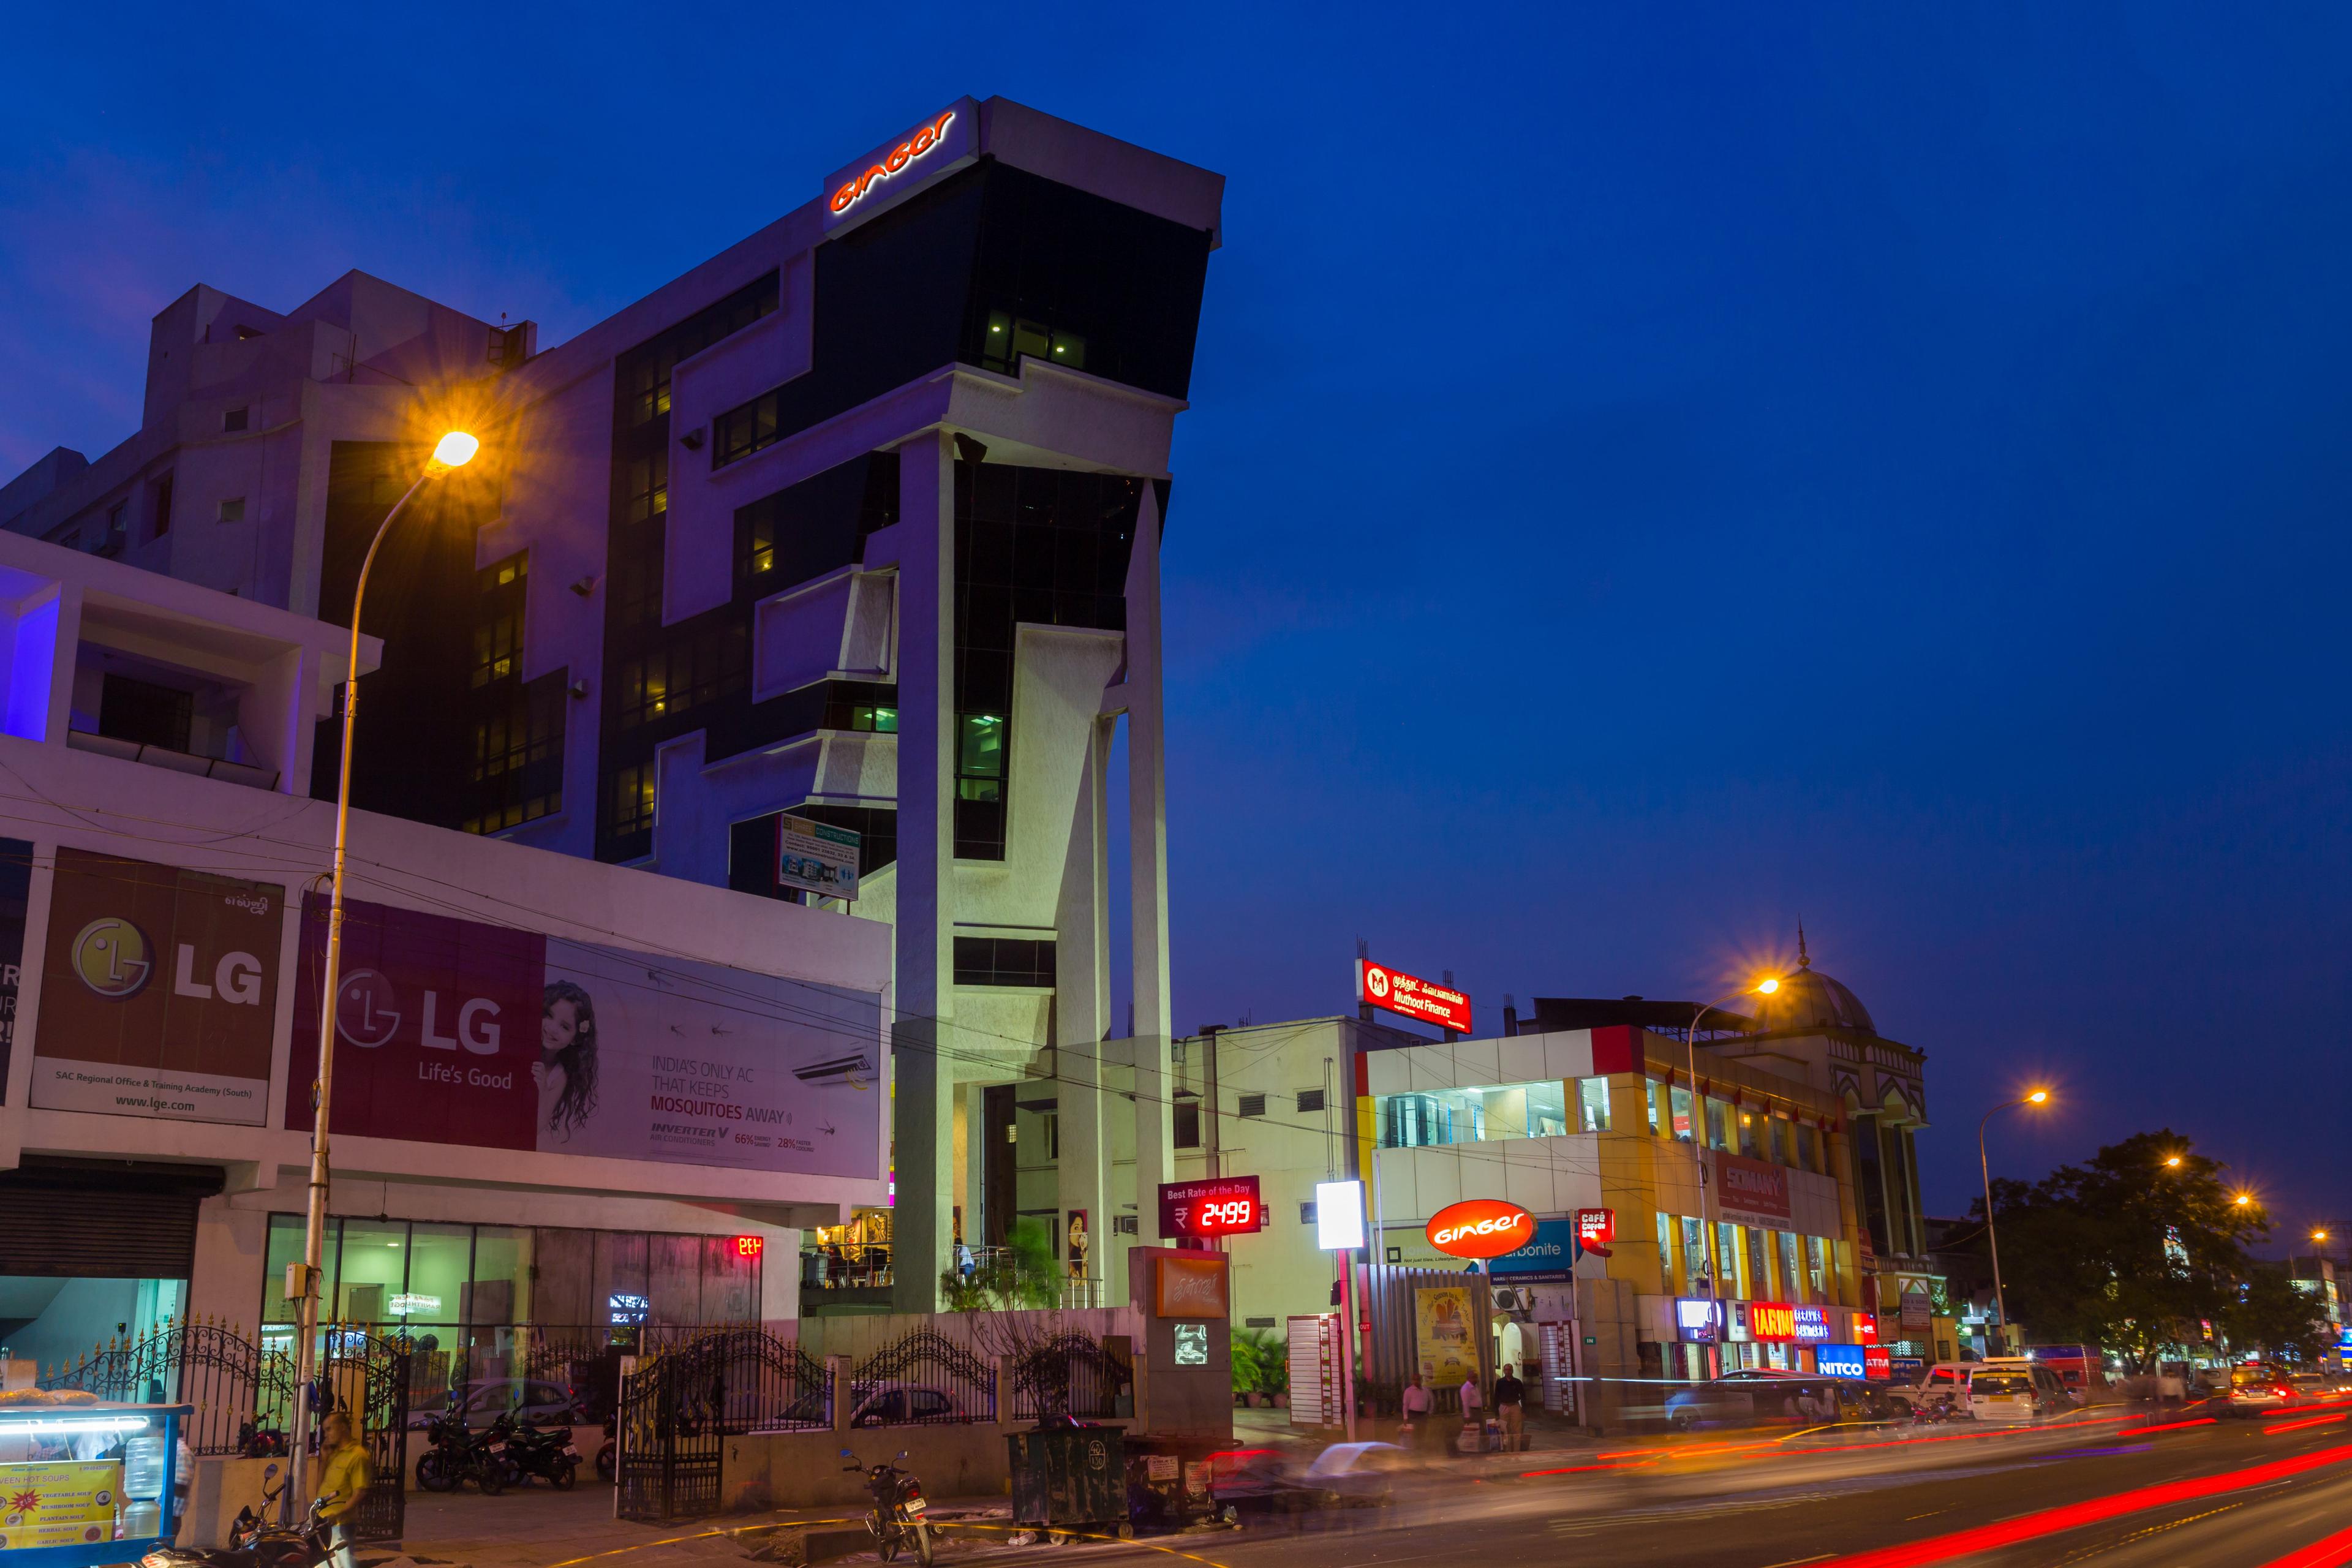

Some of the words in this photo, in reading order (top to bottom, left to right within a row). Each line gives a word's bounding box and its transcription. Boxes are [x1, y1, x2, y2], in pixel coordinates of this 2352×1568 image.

[175, 944, 262, 1005] LG
[1393, 989, 1424, 1010] Muthoot
[1424, 999, 1450, 1018] Finance
[421, 990, 502, 1055] LG
[419, 1061, 462, 1084] Life's
[468, 1068, 512, 1090] Good
[652, 1055, 698, 1076] INDIA'S
[700, 1060, 734, 1081] ONLY
[736, 1066, 754, 1083] AC
[56, 1071, 74, 1081] SAC
[77, 1073, 113, 1087] Regional
[115, 1076, 141, 1088] Office
[143, 1079, 149, 1088] &
[151, 1080, 183, 1095] Training
[185, 1082, 221, 1097] Academy
[222, 1085, 252, 1099] (South)
[652, 1075, 686, 1095] THAT
[690, 1079, 729, 1099] KEEPS
[116, 1094, 195, 1112] www.lge.com
[650, 1095, 742, 1120] MOSQUITOES
[745, 1107, 785, 1125] AWAY
[651, 1122, 717, 1138] INVERTER
[717, 1126, 729, 1139] V
[663, 1134, 715, 1147] CONDITIONERS
[734, 1133, 754, 1145] 66%
[777, 1137, 796, 1149] 28%
[1167, 1190, 1186, 1199] Best
[1188, 1188, 1206, 1198] Rate
[1208, 1186, 1217, 1196] of
[1218, 1185, 1232, 1195] the
[1234, 1185, 1250, 1195] Day
[1202, 1200, 1250, 1226] 2499
[1819, 1362, 1863, 1376] NITCO
[1866, 1358, 1890, 1368] ATM
